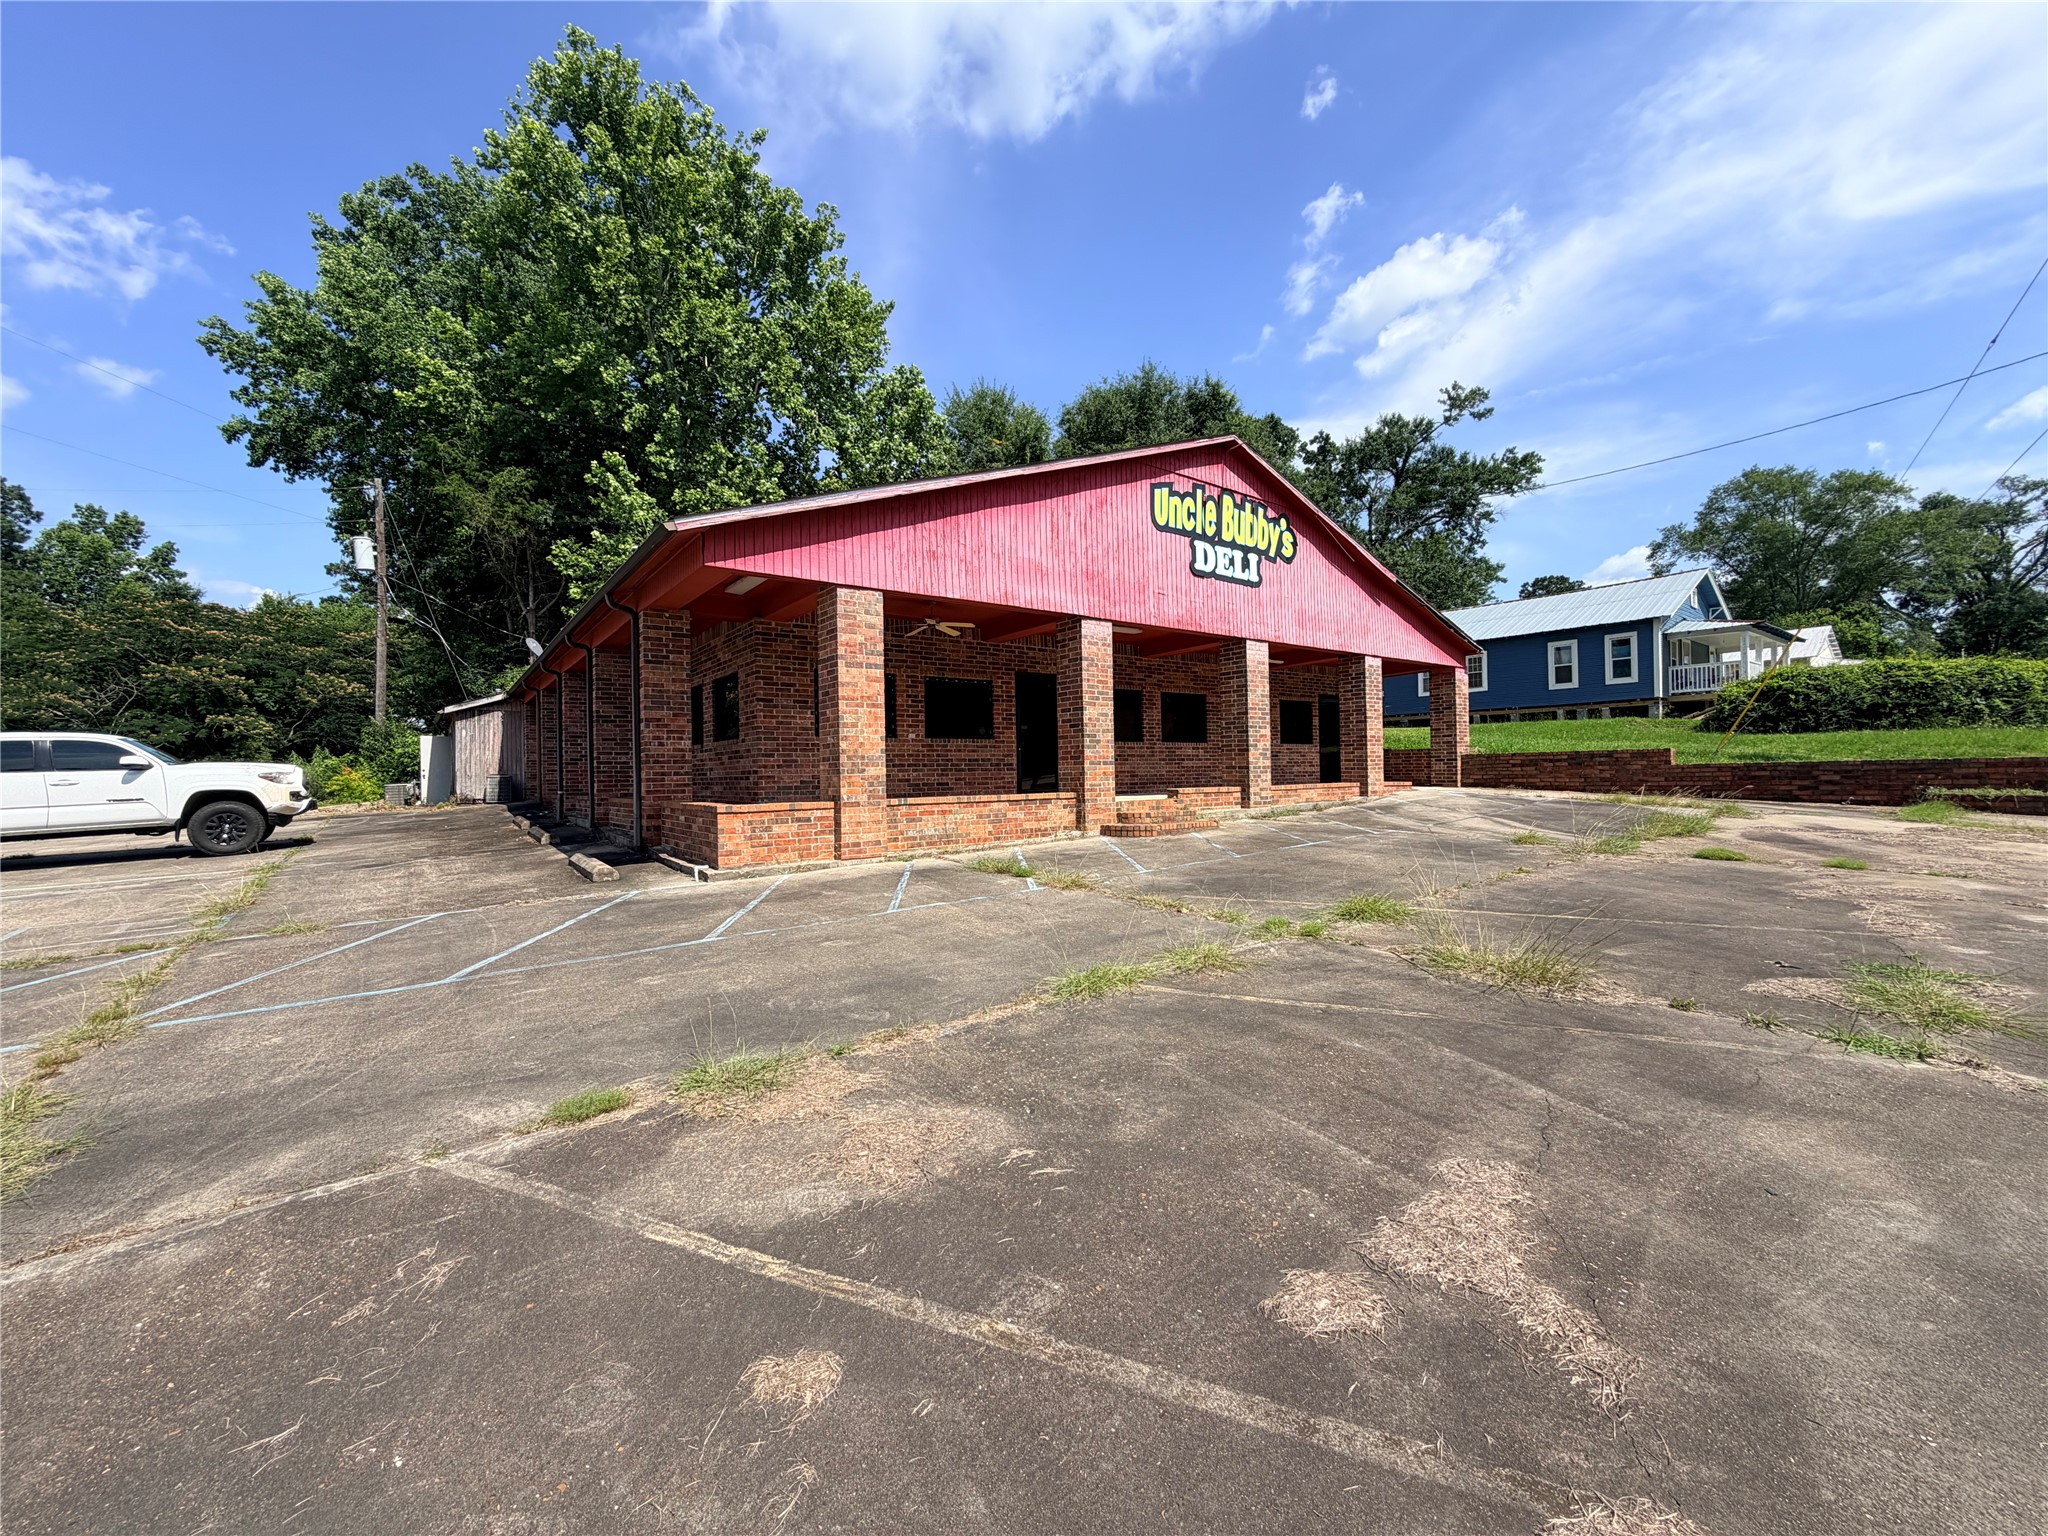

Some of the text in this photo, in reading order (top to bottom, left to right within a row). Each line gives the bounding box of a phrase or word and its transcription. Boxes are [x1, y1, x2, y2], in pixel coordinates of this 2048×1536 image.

[1154, 487, 1294, 558] Uncle Bubby's
[1193, 540, 1260, 582] DELI
